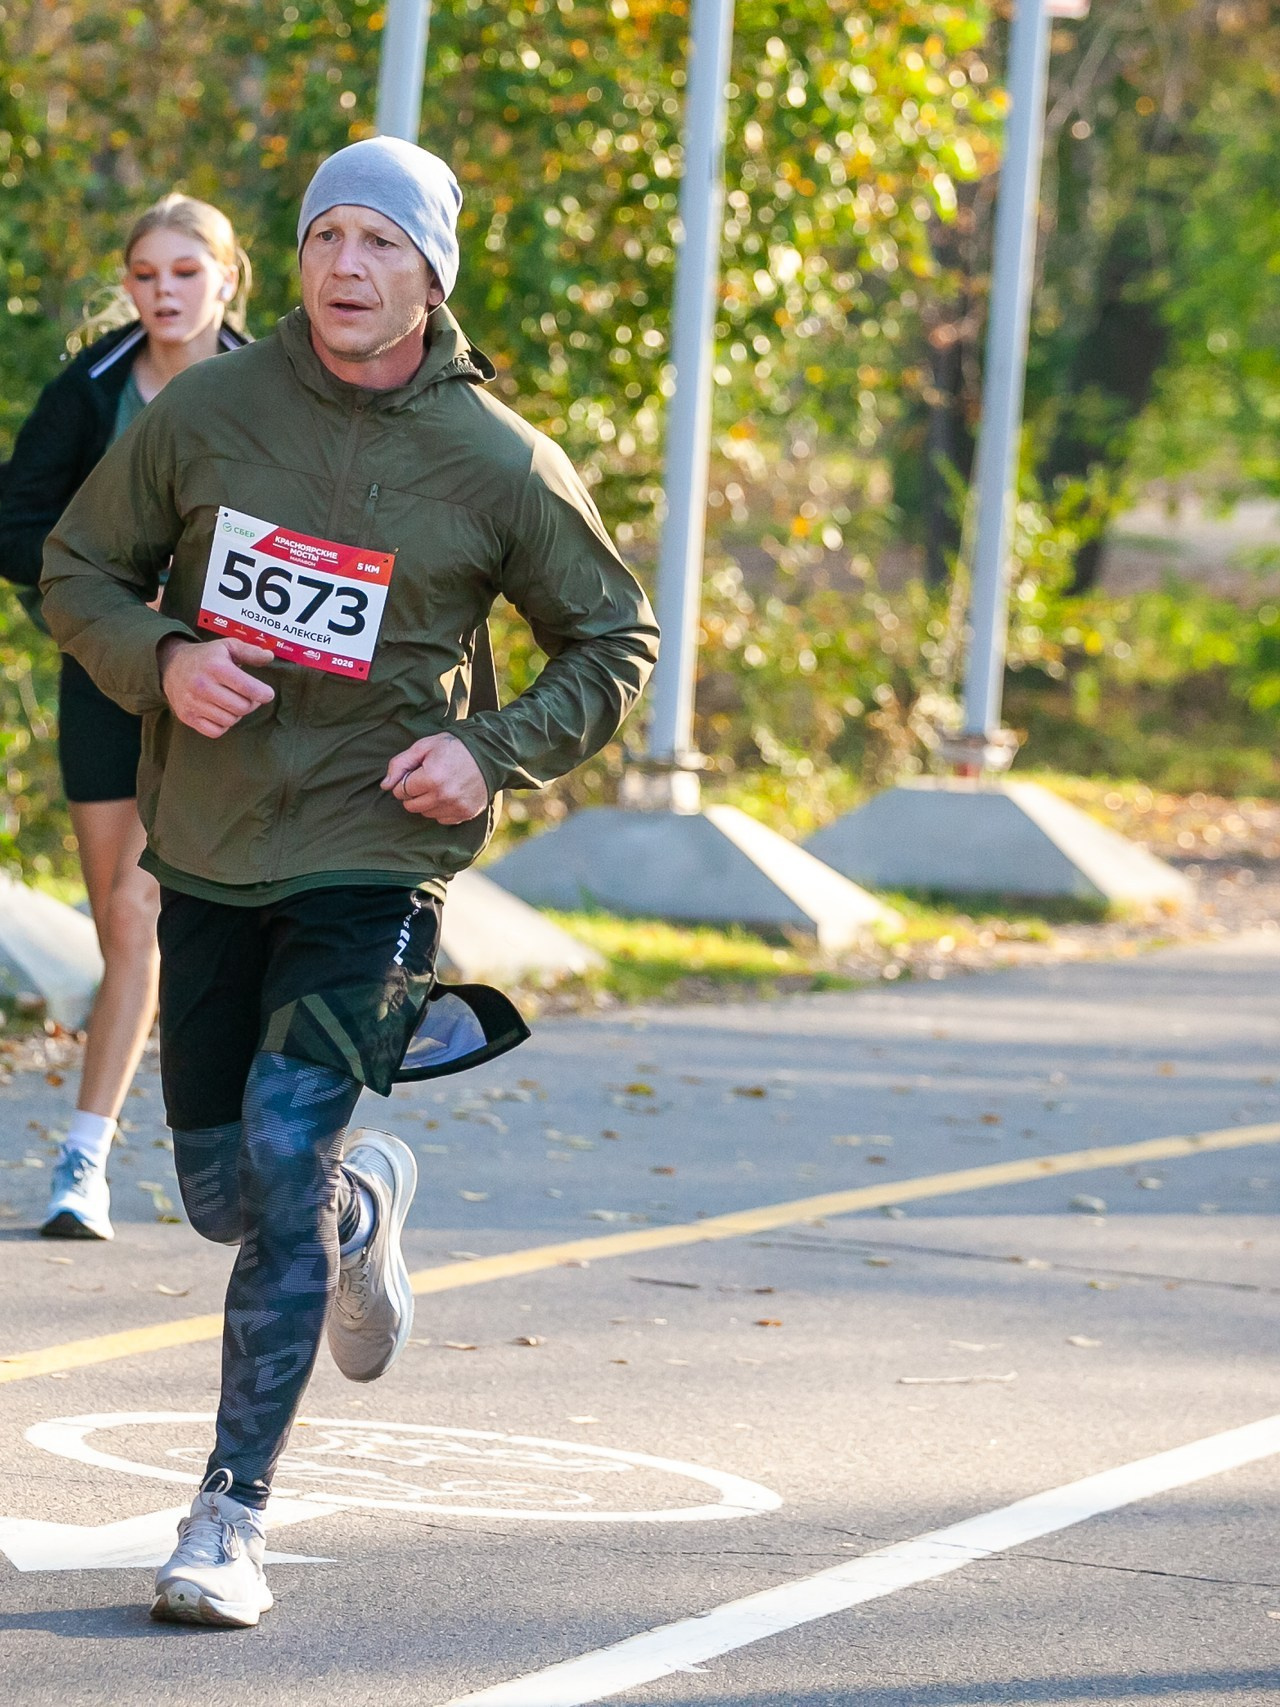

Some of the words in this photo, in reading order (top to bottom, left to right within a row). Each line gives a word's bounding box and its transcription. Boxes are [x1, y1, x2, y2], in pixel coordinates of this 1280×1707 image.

[234, 527, 255, 538] СБЕР
[274, 535, 338, 560] КРАСНОЯРСКИЕ
[289, 548, 319, 562] МОСТЫ
[356, 562, 364, 571] 5
[218, 549, 369, 636] 5673
[240, 607, 281, 630] КОЗЛОВ
[282, 624, 332, 645] АЛЕКСЕЙ
[331, 657, 354, 668] 2026
